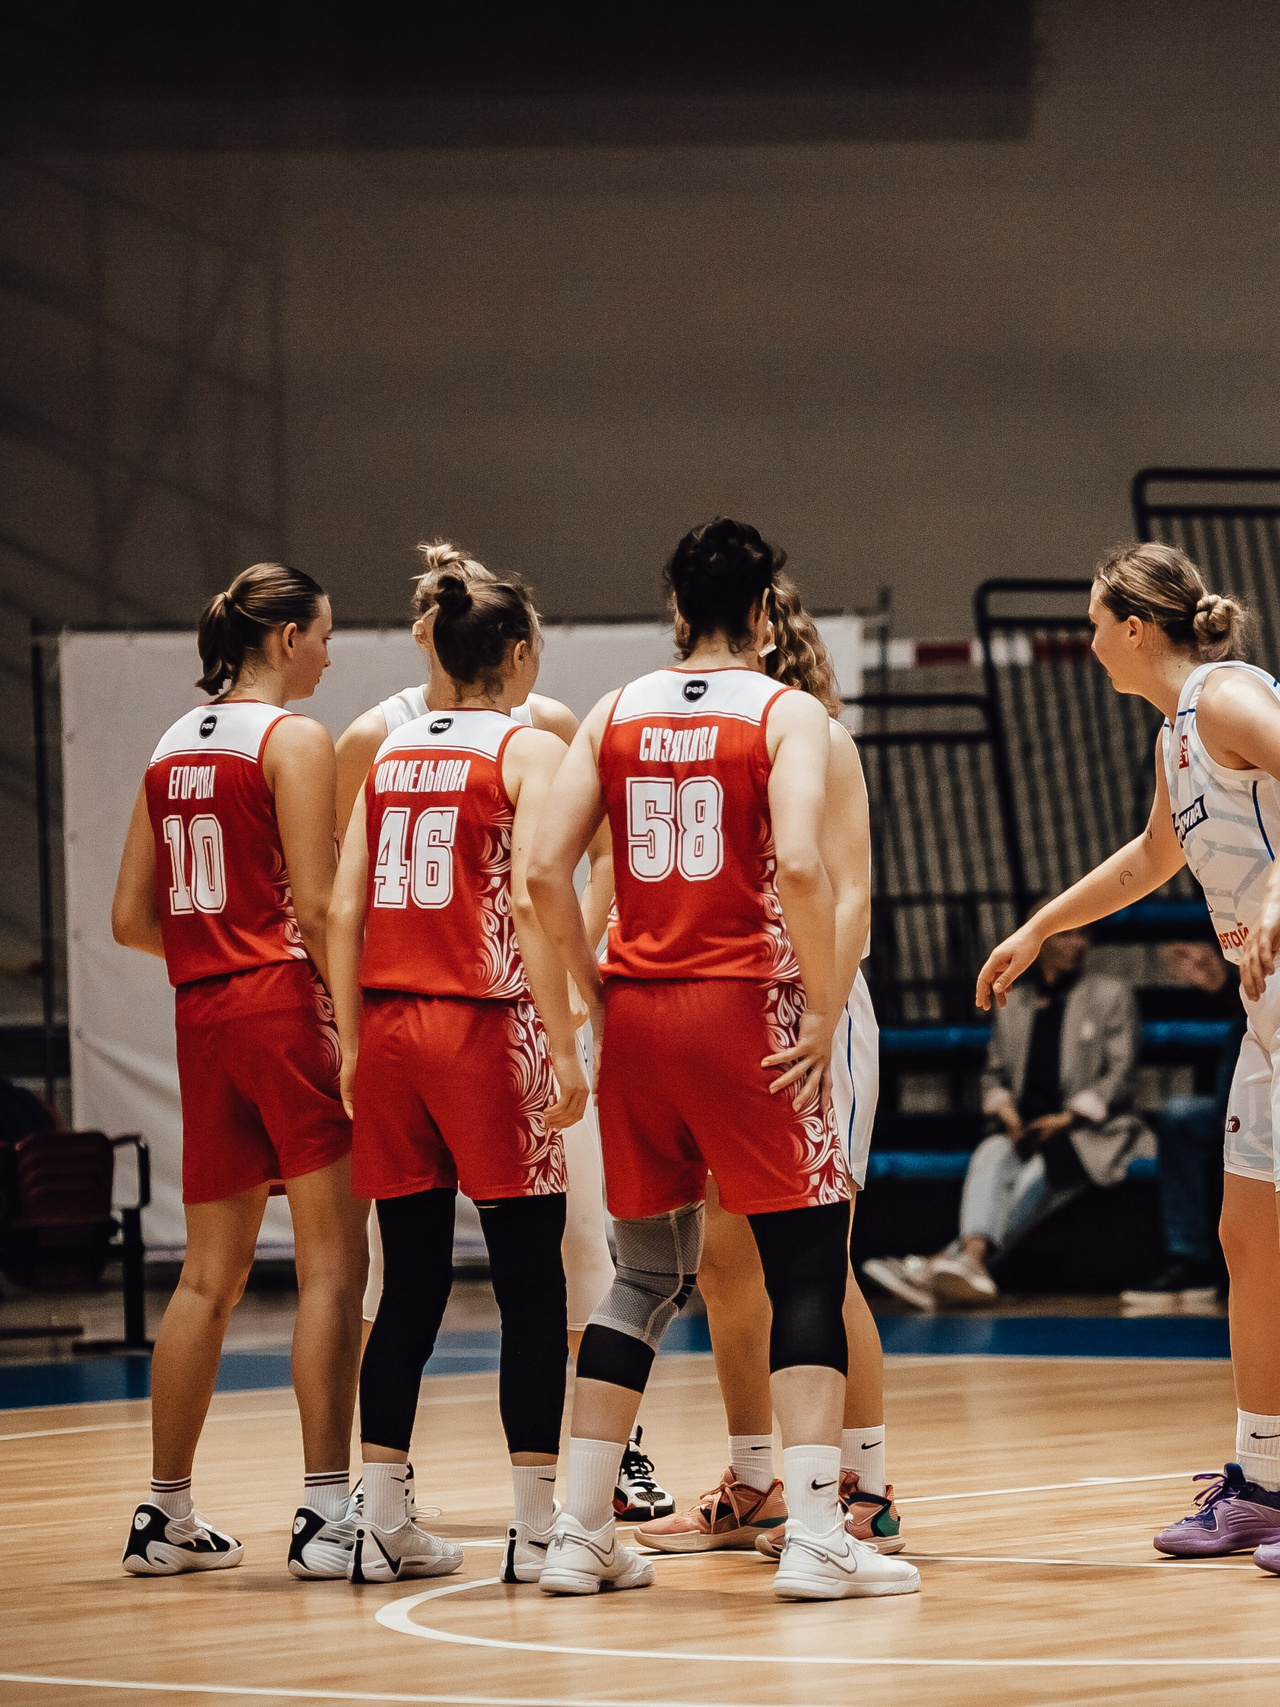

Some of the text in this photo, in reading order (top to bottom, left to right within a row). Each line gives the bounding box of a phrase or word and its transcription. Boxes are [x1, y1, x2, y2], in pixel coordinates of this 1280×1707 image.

[639, 726, 718, 762] СИЗЯКОВА
[168, 765, 215, 799] ЕГОРОВА
[374, 807, 458, 909] 46
[626, 776, 724, 882] 58
[163, 814, 226, 915] 10
[1216, 922, 1250, 950] етай
